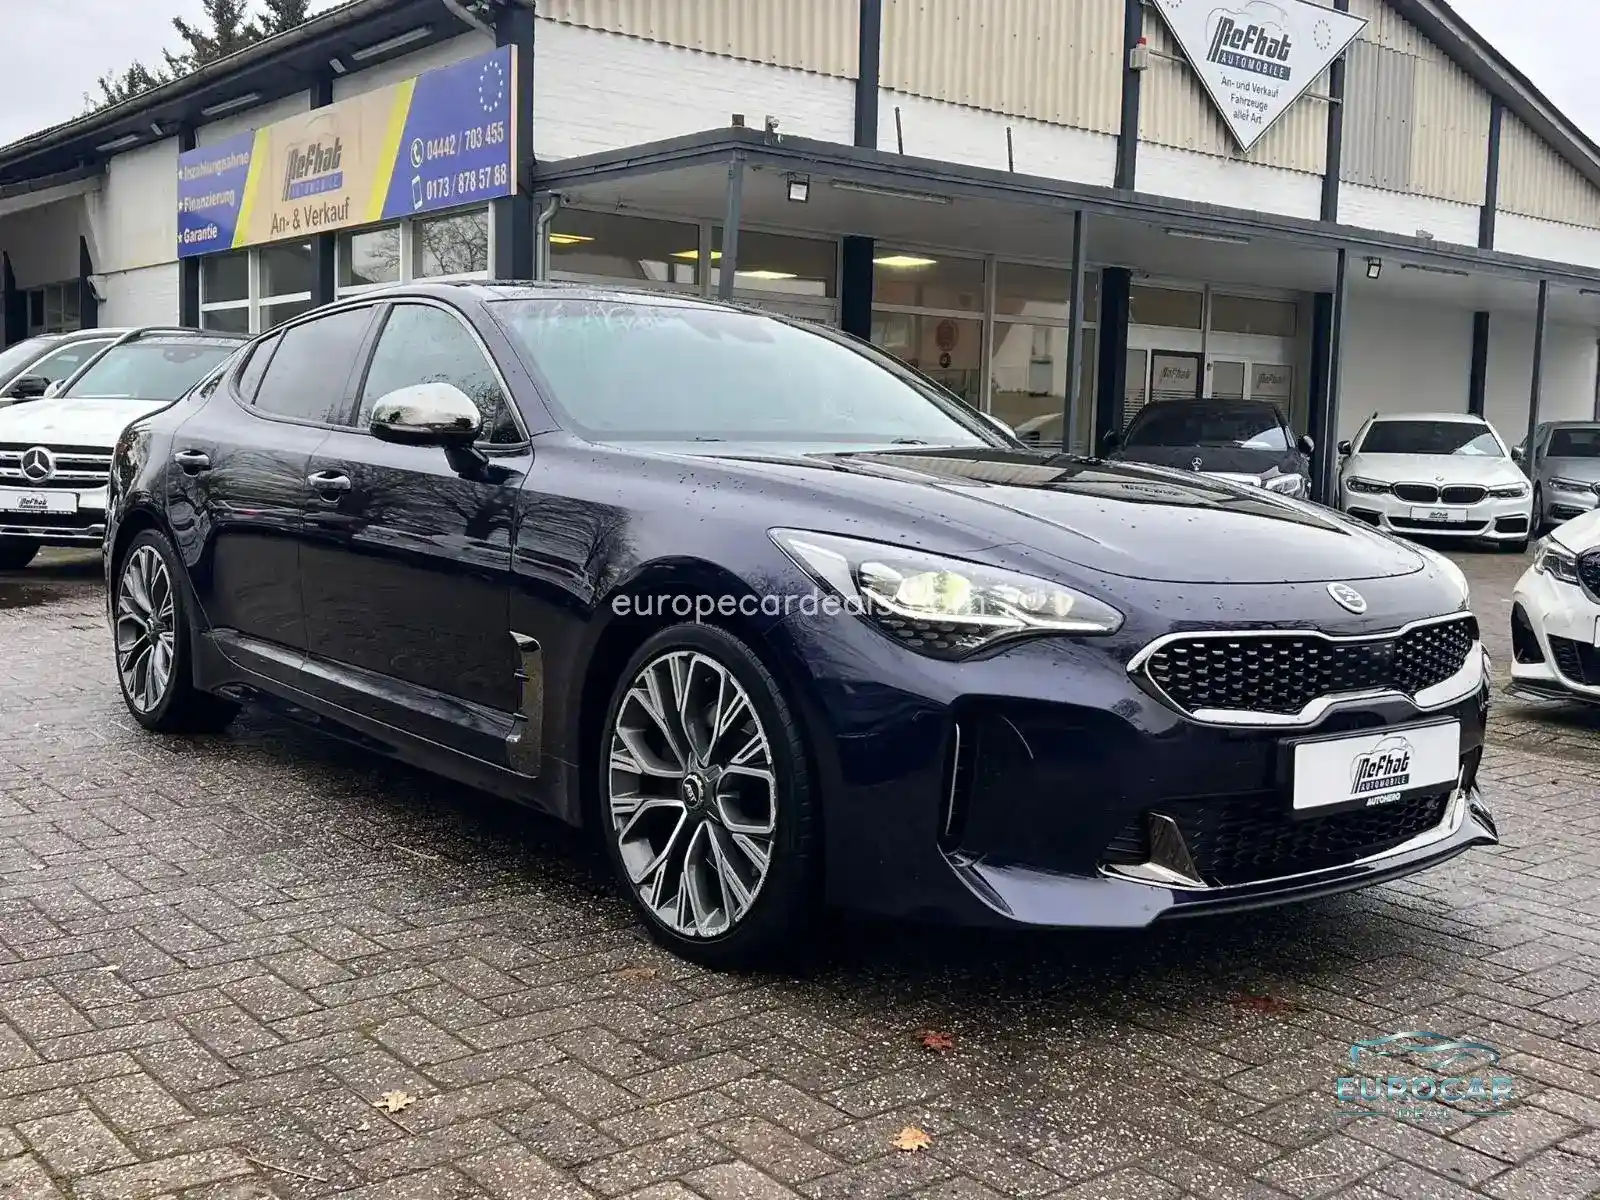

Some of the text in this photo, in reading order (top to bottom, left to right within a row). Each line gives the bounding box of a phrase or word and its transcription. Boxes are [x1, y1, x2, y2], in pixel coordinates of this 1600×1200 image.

[1220, 51, 1286, 79] AUTOMOBILE
[1221, 76, 1280, 98] An- und Verkauf
[1230, 93, 1268, 112] Fahrzeuge
[1233, 109, 1262, 124] aller Art
[426, 134, 456, 160] 04442
[464, 127, 482, 151] 703
[485, 121, 504, 145] 455
[426, 176, 450, 200] 0173
[458, 171, 476, 194] 878
[478, 166, 491, 189] 57
[494, 163, 507, 186] 88
[184, 189, 235, 213] Finanzierung
[292, 207, 301, 230] &
[304, 196, 350, 228] Verkauf
[184, 223, 218, 243] Garantie
[1360, 775, 1407, 791] AUTOMOBILE
